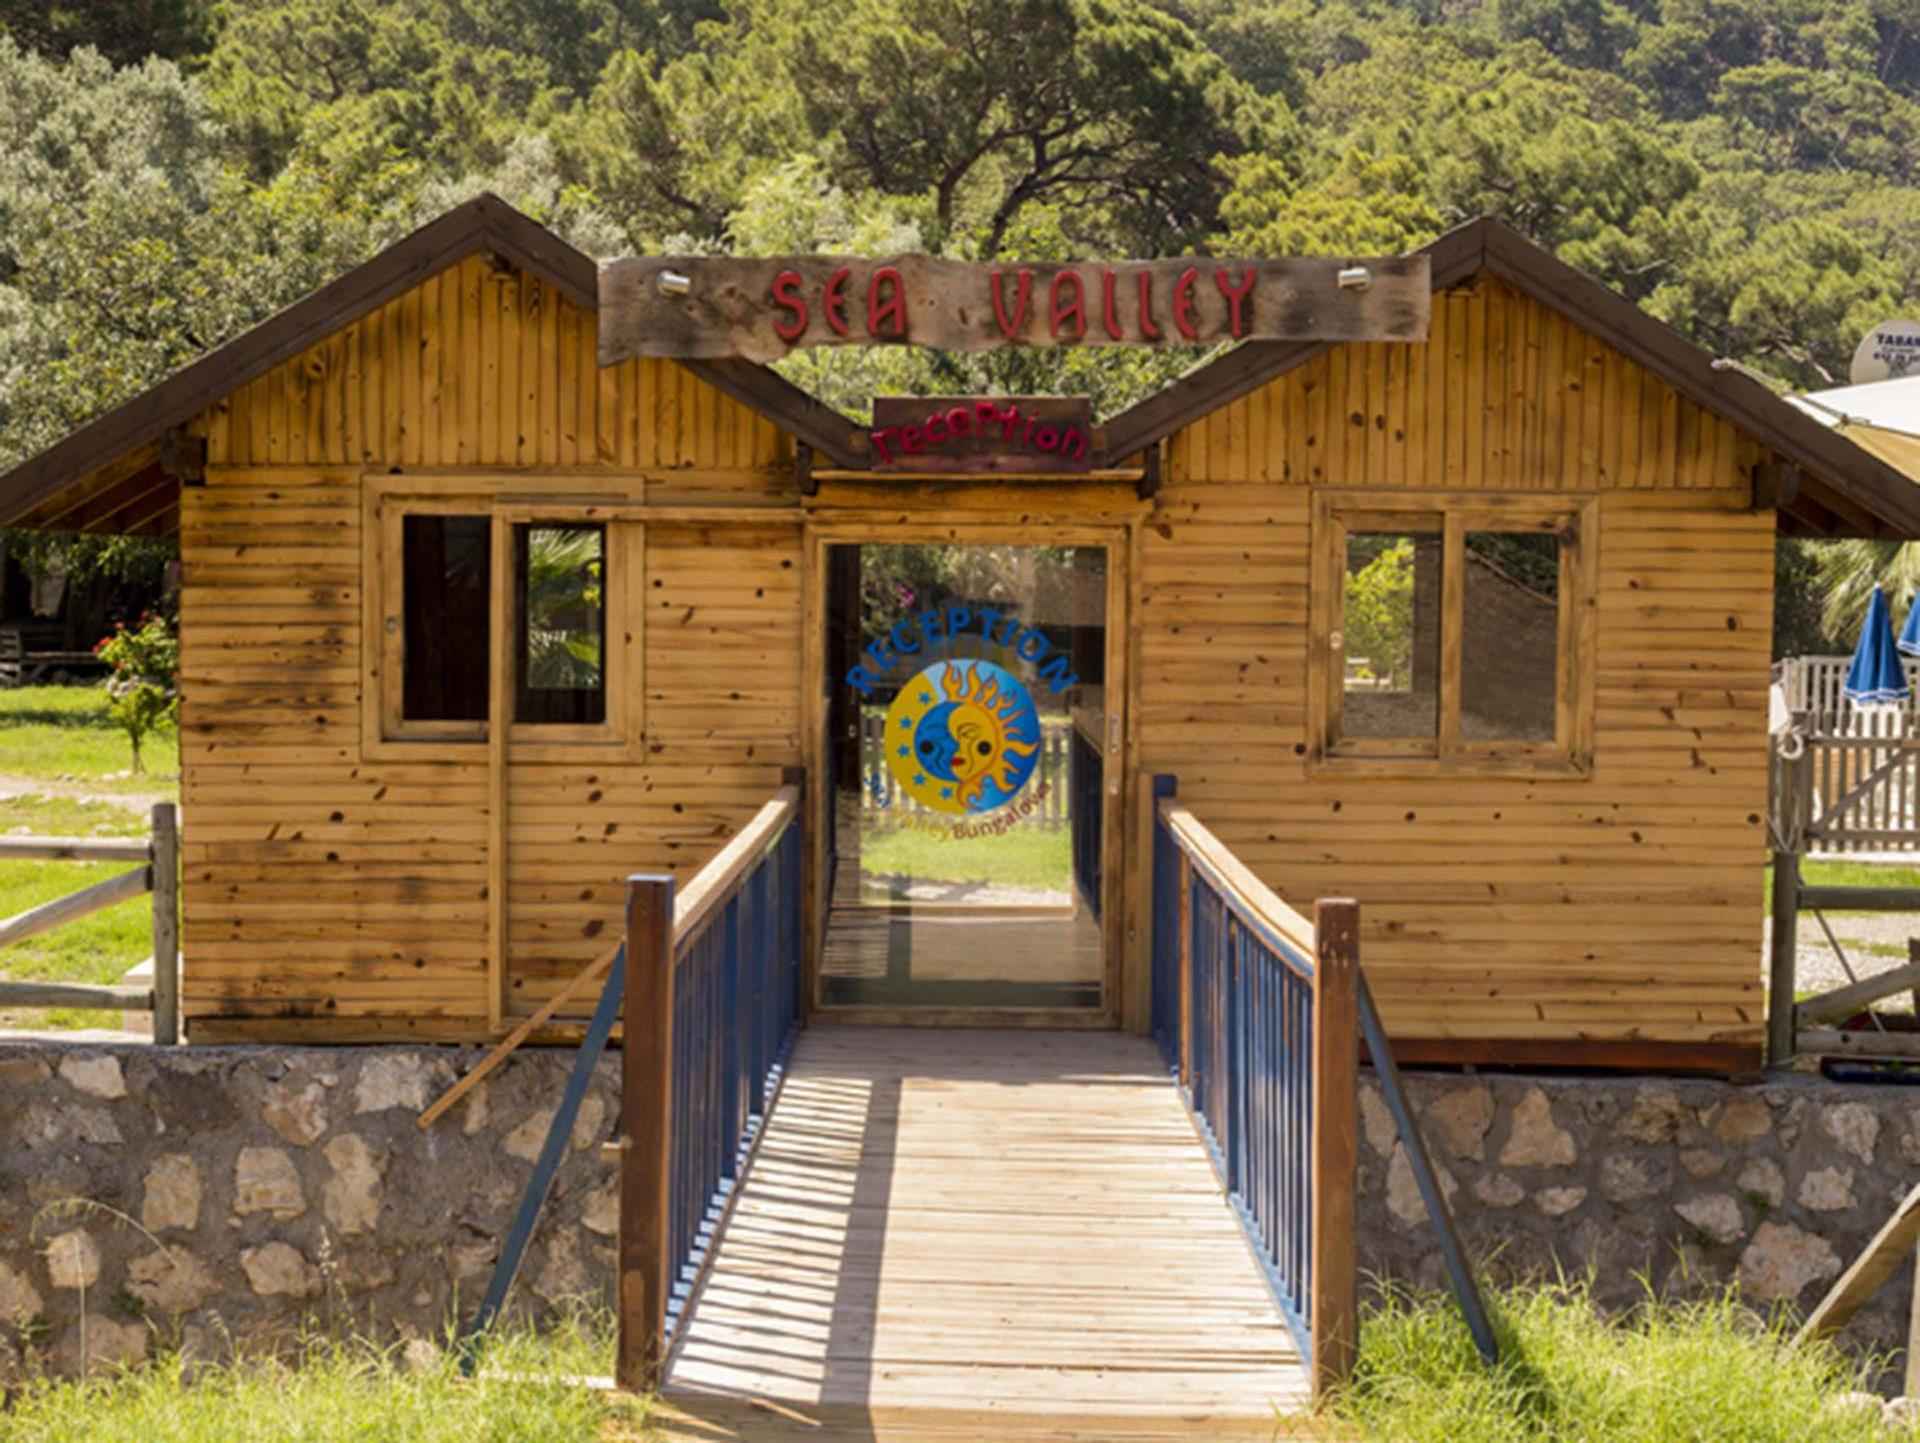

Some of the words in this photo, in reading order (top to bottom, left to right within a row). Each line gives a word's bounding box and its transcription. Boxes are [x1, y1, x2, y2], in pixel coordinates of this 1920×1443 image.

[770, 267, 905, 341] SEA
[989, 265, 1256, 339] VALLEY
[870, 402, 1089, 465] reception
[845, 607, 1080, 694] RECEPTION
